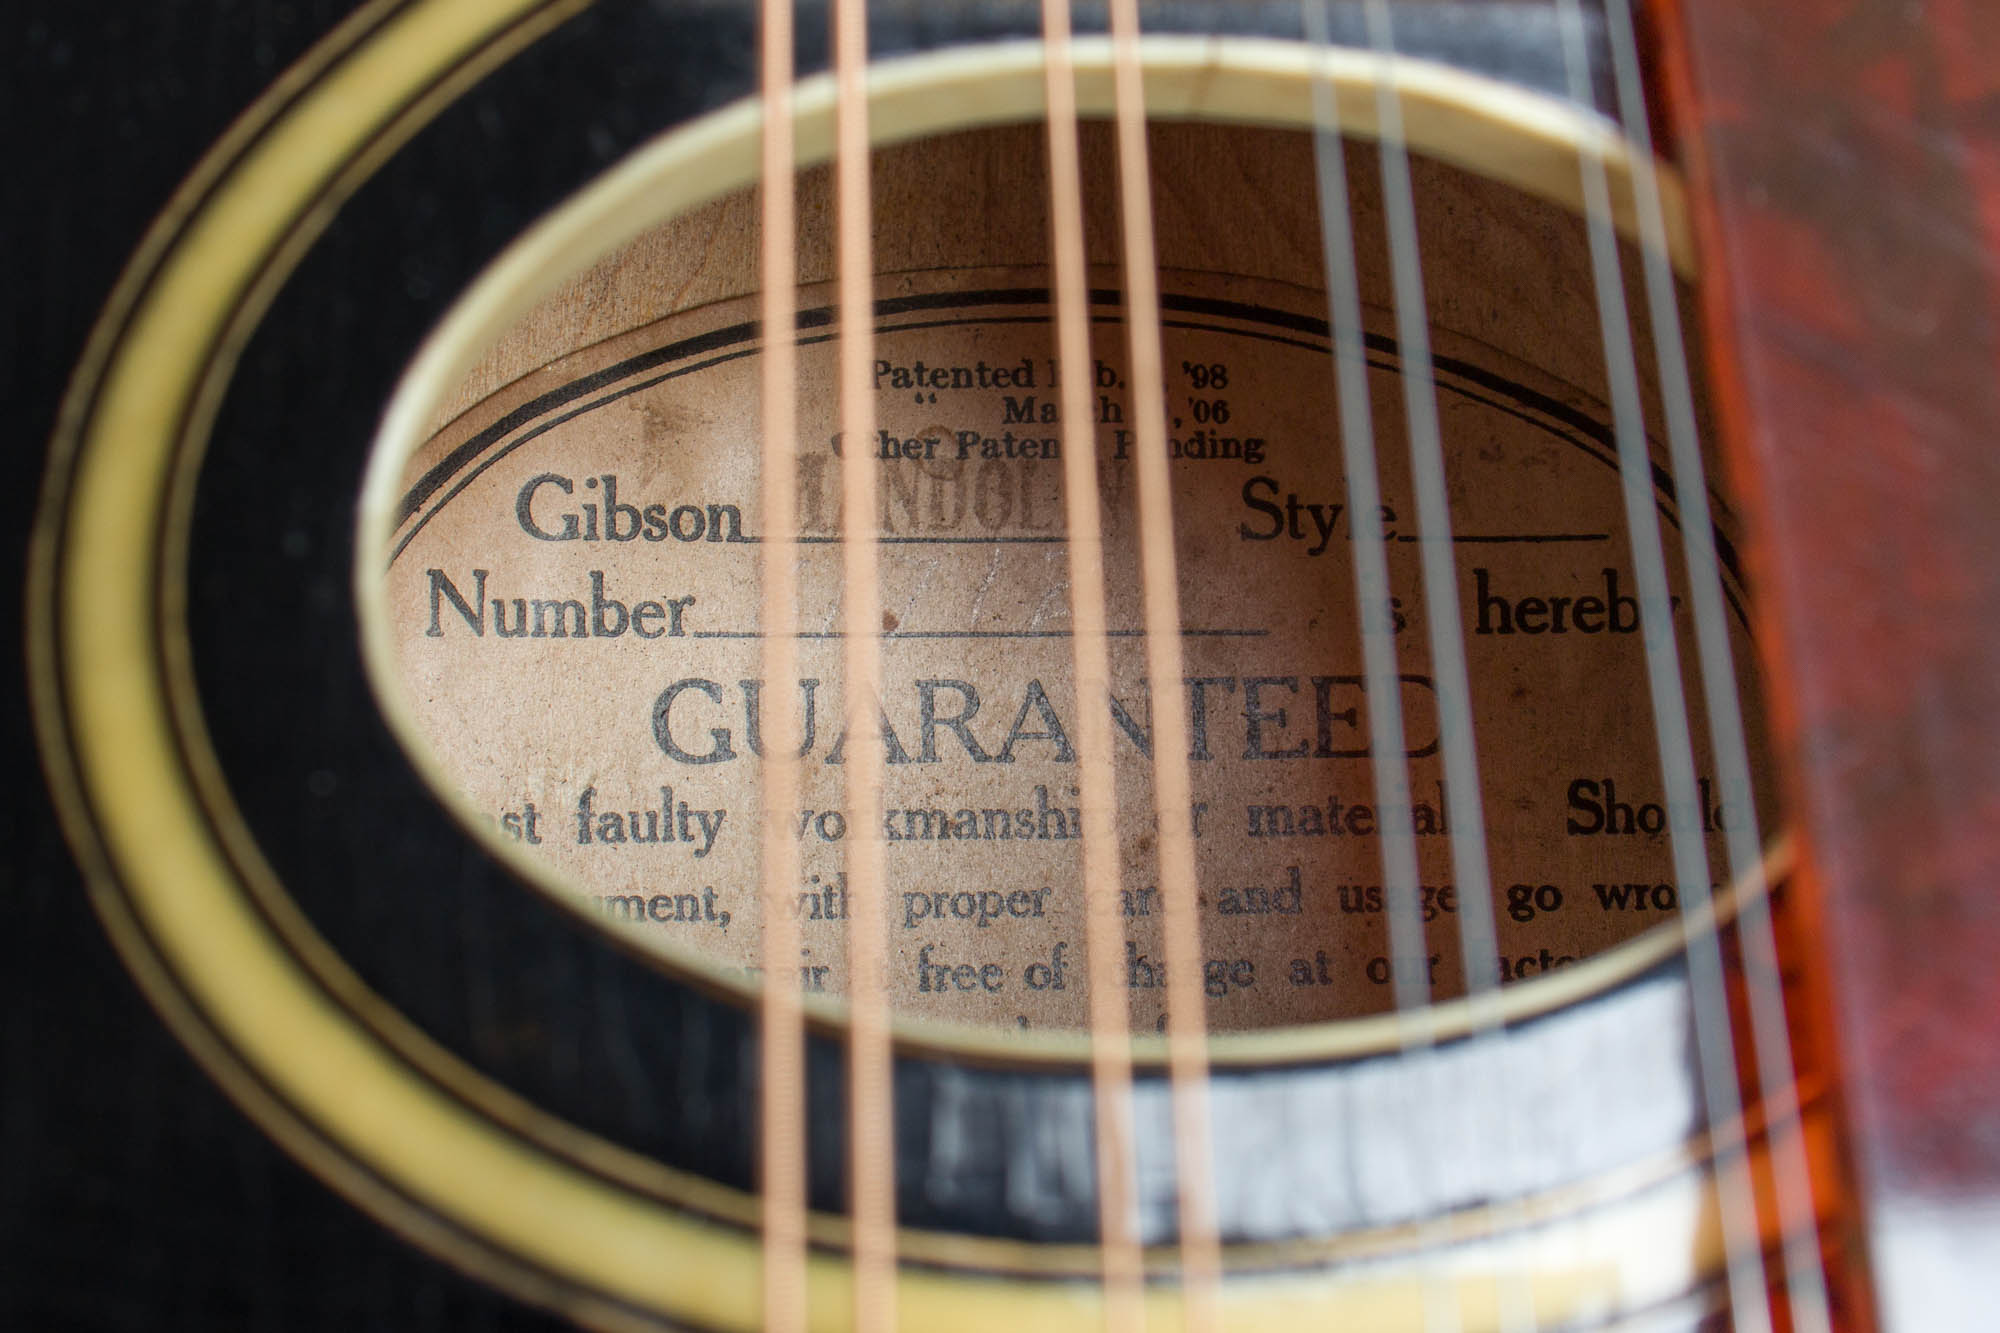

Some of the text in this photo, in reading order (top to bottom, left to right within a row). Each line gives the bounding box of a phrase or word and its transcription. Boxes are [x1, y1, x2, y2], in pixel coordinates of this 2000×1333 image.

[871, 360, 1035, 389] Patented
[1002, 396, 1122, 425] Mah
[955, 432, 1062, 460] Paten
[1113, 429, 1267, 464] Pnding
[515, 472, 743, 542] Gibson
[1239, 475, 1398, 557] Stye
[426, 568, 697, 638] Number
[1472, 567, 1678, 637] hereb
[576, 785, 728, 858] faulty
[1247, 779, 1450, 837] mateal
[903, 885, 1052, 930] proper
[1217, 866, 1303, 916] and
[1337, 884, 1459, 923] usge
[1507, 882, 1564, 923] go
[918, 943, 1003, 994] free
[1024, 941, 1069, 991] of
[1288, 949, 1333, 986] at
[1366, 953, 1441, 986] or
